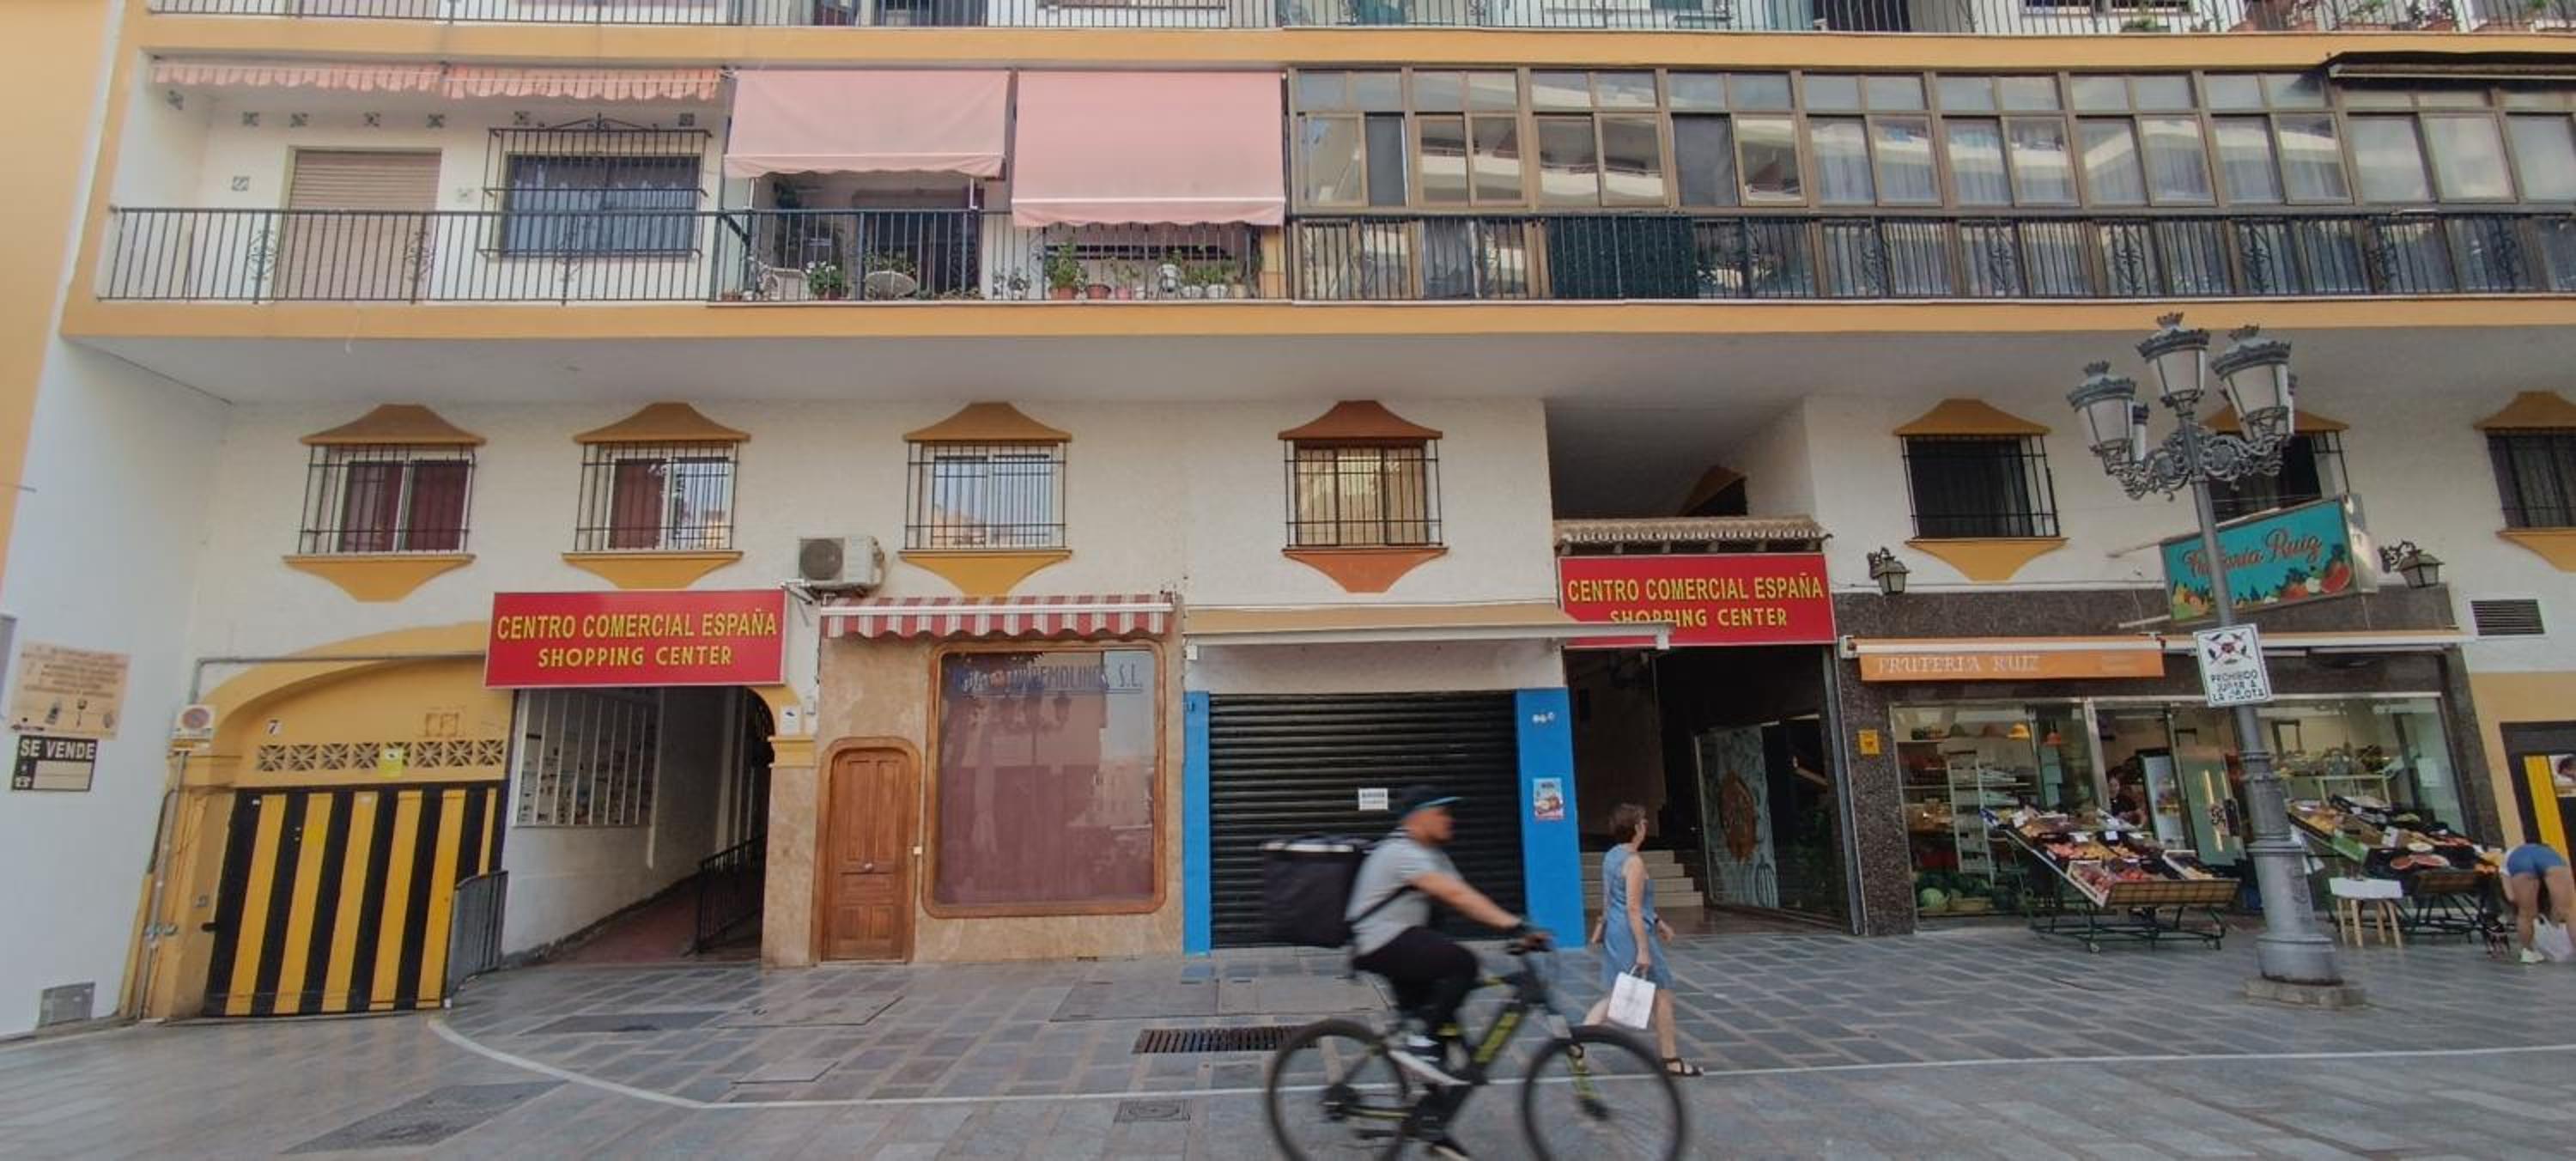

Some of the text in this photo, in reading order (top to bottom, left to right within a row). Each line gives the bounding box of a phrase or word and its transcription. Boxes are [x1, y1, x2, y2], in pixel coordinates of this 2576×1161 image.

[2266, 527, 2322, 563] Ruiz
[1567, 571, 1825, 602] CENTRO COMERCIAL ESPAÑA
[496, 607, 778, 640] CENTRO COMERCIAL ESPAÑA
[1609, 607, 1787, 627] SHOPPING CENTER
[538, 645, 732, 668] SHOPPING CENTER
[1992, 654, 2040, 673] RUIZ
[269, 718, 280, 736] 7
[20, 739, 95, 759] SE VENDE
